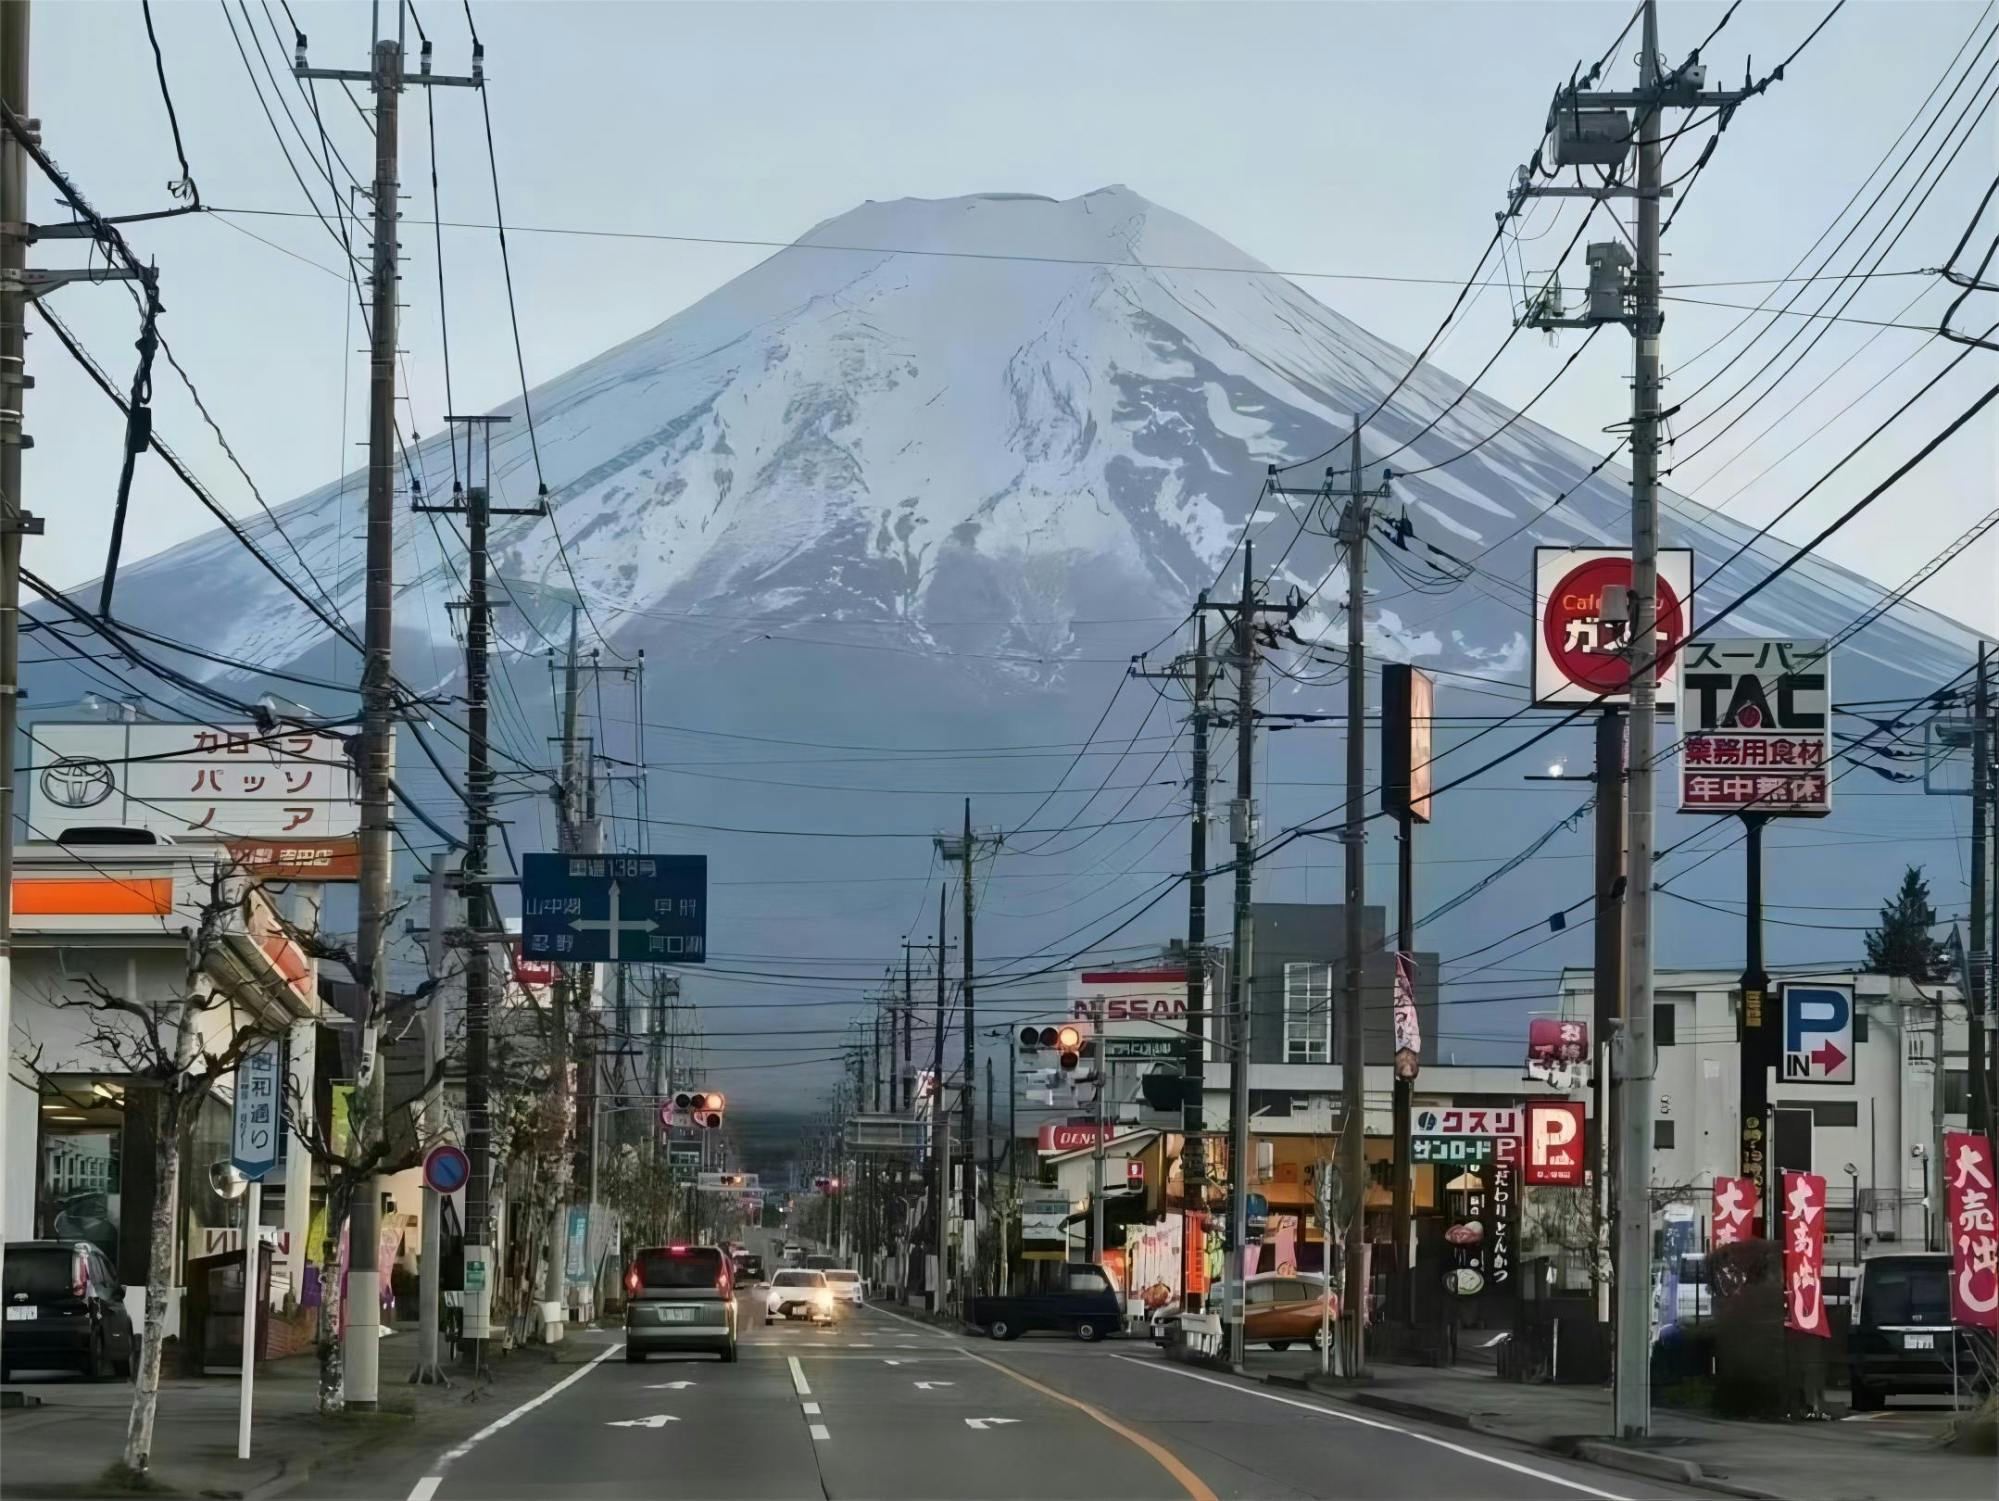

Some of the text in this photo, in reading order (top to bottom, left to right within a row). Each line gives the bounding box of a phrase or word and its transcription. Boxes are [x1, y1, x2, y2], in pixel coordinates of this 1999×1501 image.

[1684, 642, 1826, 669] スーパー
[1684, 673, 1825, 729] TAC
[193, 731, 314, 754] カロラ
[1685, 737, 1825, 766] 業務用食材
[191, 768, 313, 794] パッソ
[1688, 775, 1822, 802] 年中無休
[187, 807, 314, 831] ノア
[1074, 1000, 1188, 1020] NSSAN
[1787, 989, 1850, 1052] P
[1787, 1054, 1810, 1077] IN
[1442, 1111, 1515, 1133] クスリ
[1413, 1140, 1491, 1160] サンロード
[1532, 1110, 1577, 1166] P
[1953, 1144, 1998, 1313] 大売出し
